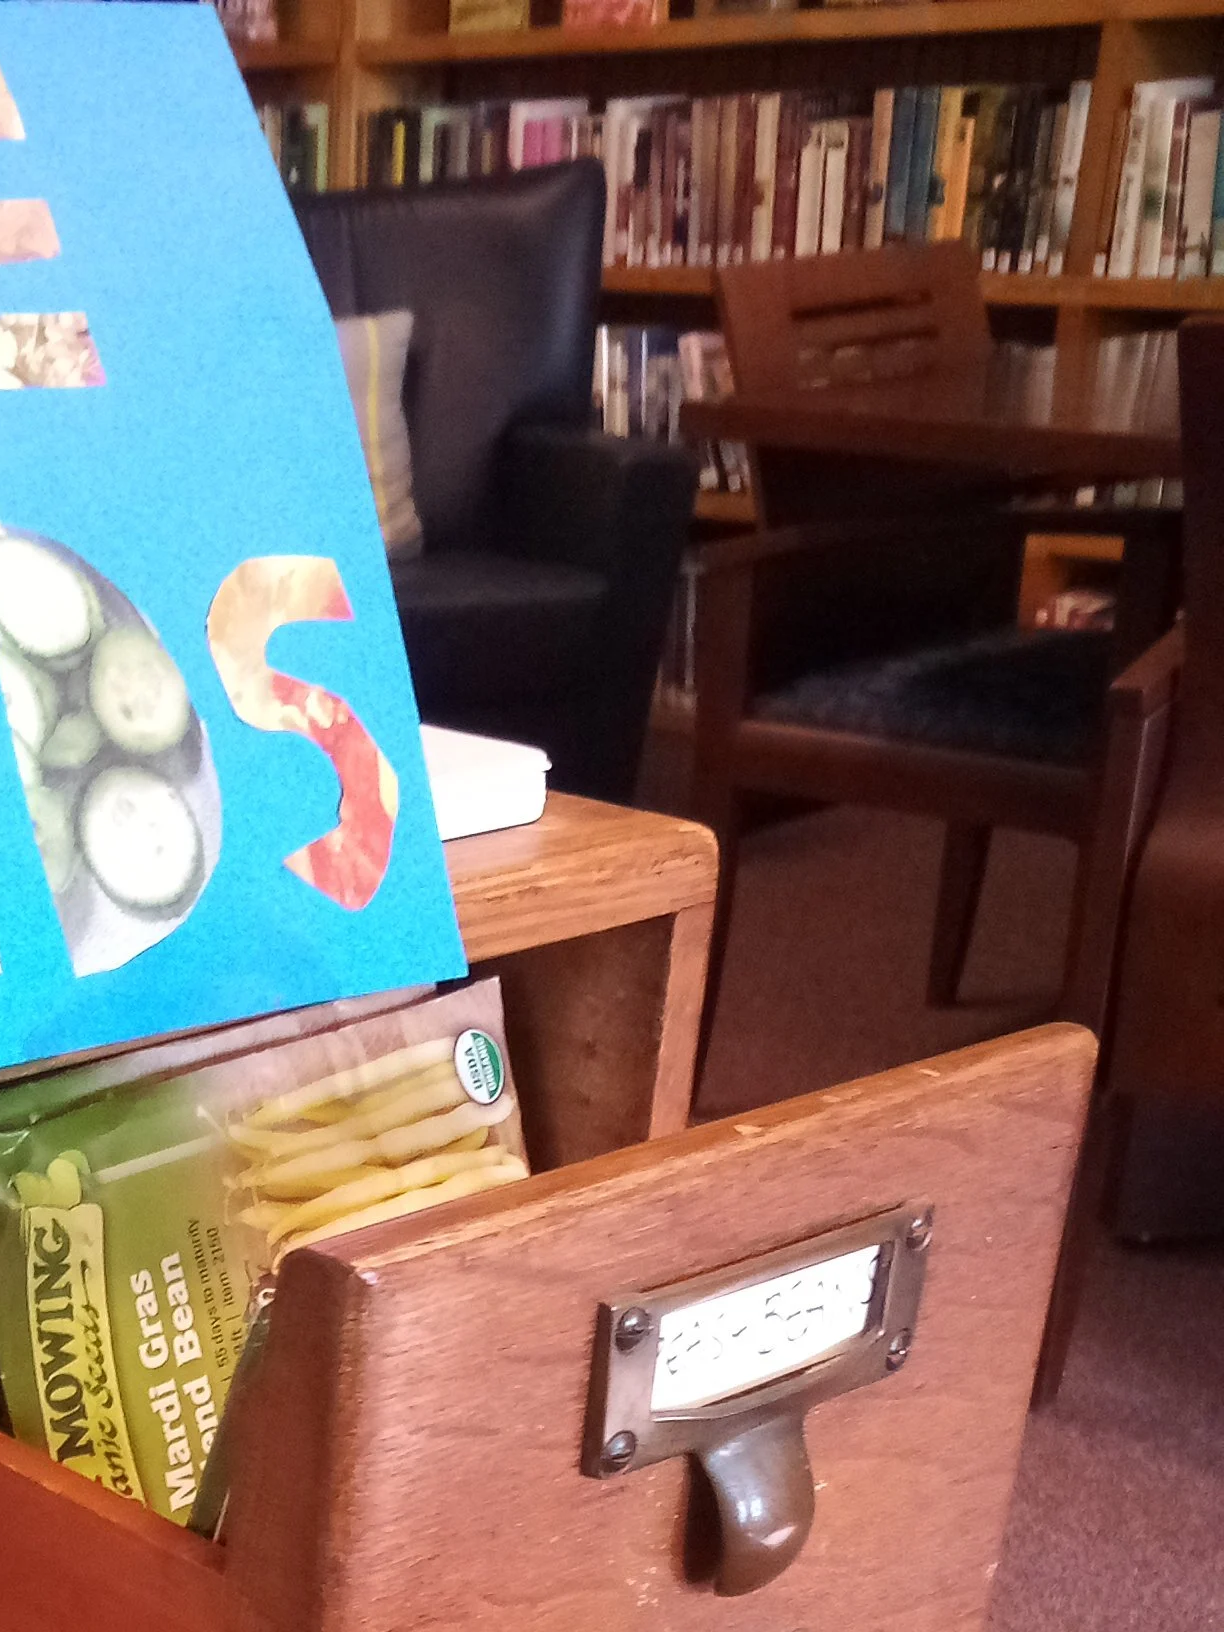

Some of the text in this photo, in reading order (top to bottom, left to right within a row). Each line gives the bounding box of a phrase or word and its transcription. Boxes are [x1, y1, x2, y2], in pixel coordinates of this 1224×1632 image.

[160, 1250, 204, 1368] Bean
[187, 1218, 210, 1285] maturity
[203, 1287, 215, 1304] to
[33, 1217, 96, 1463] MOWING
[77, 1259, 113, 1409] Seeds
[207, 1306, 224, 1345] days
[130, 1268, 197, 1513] Mardi Gras
